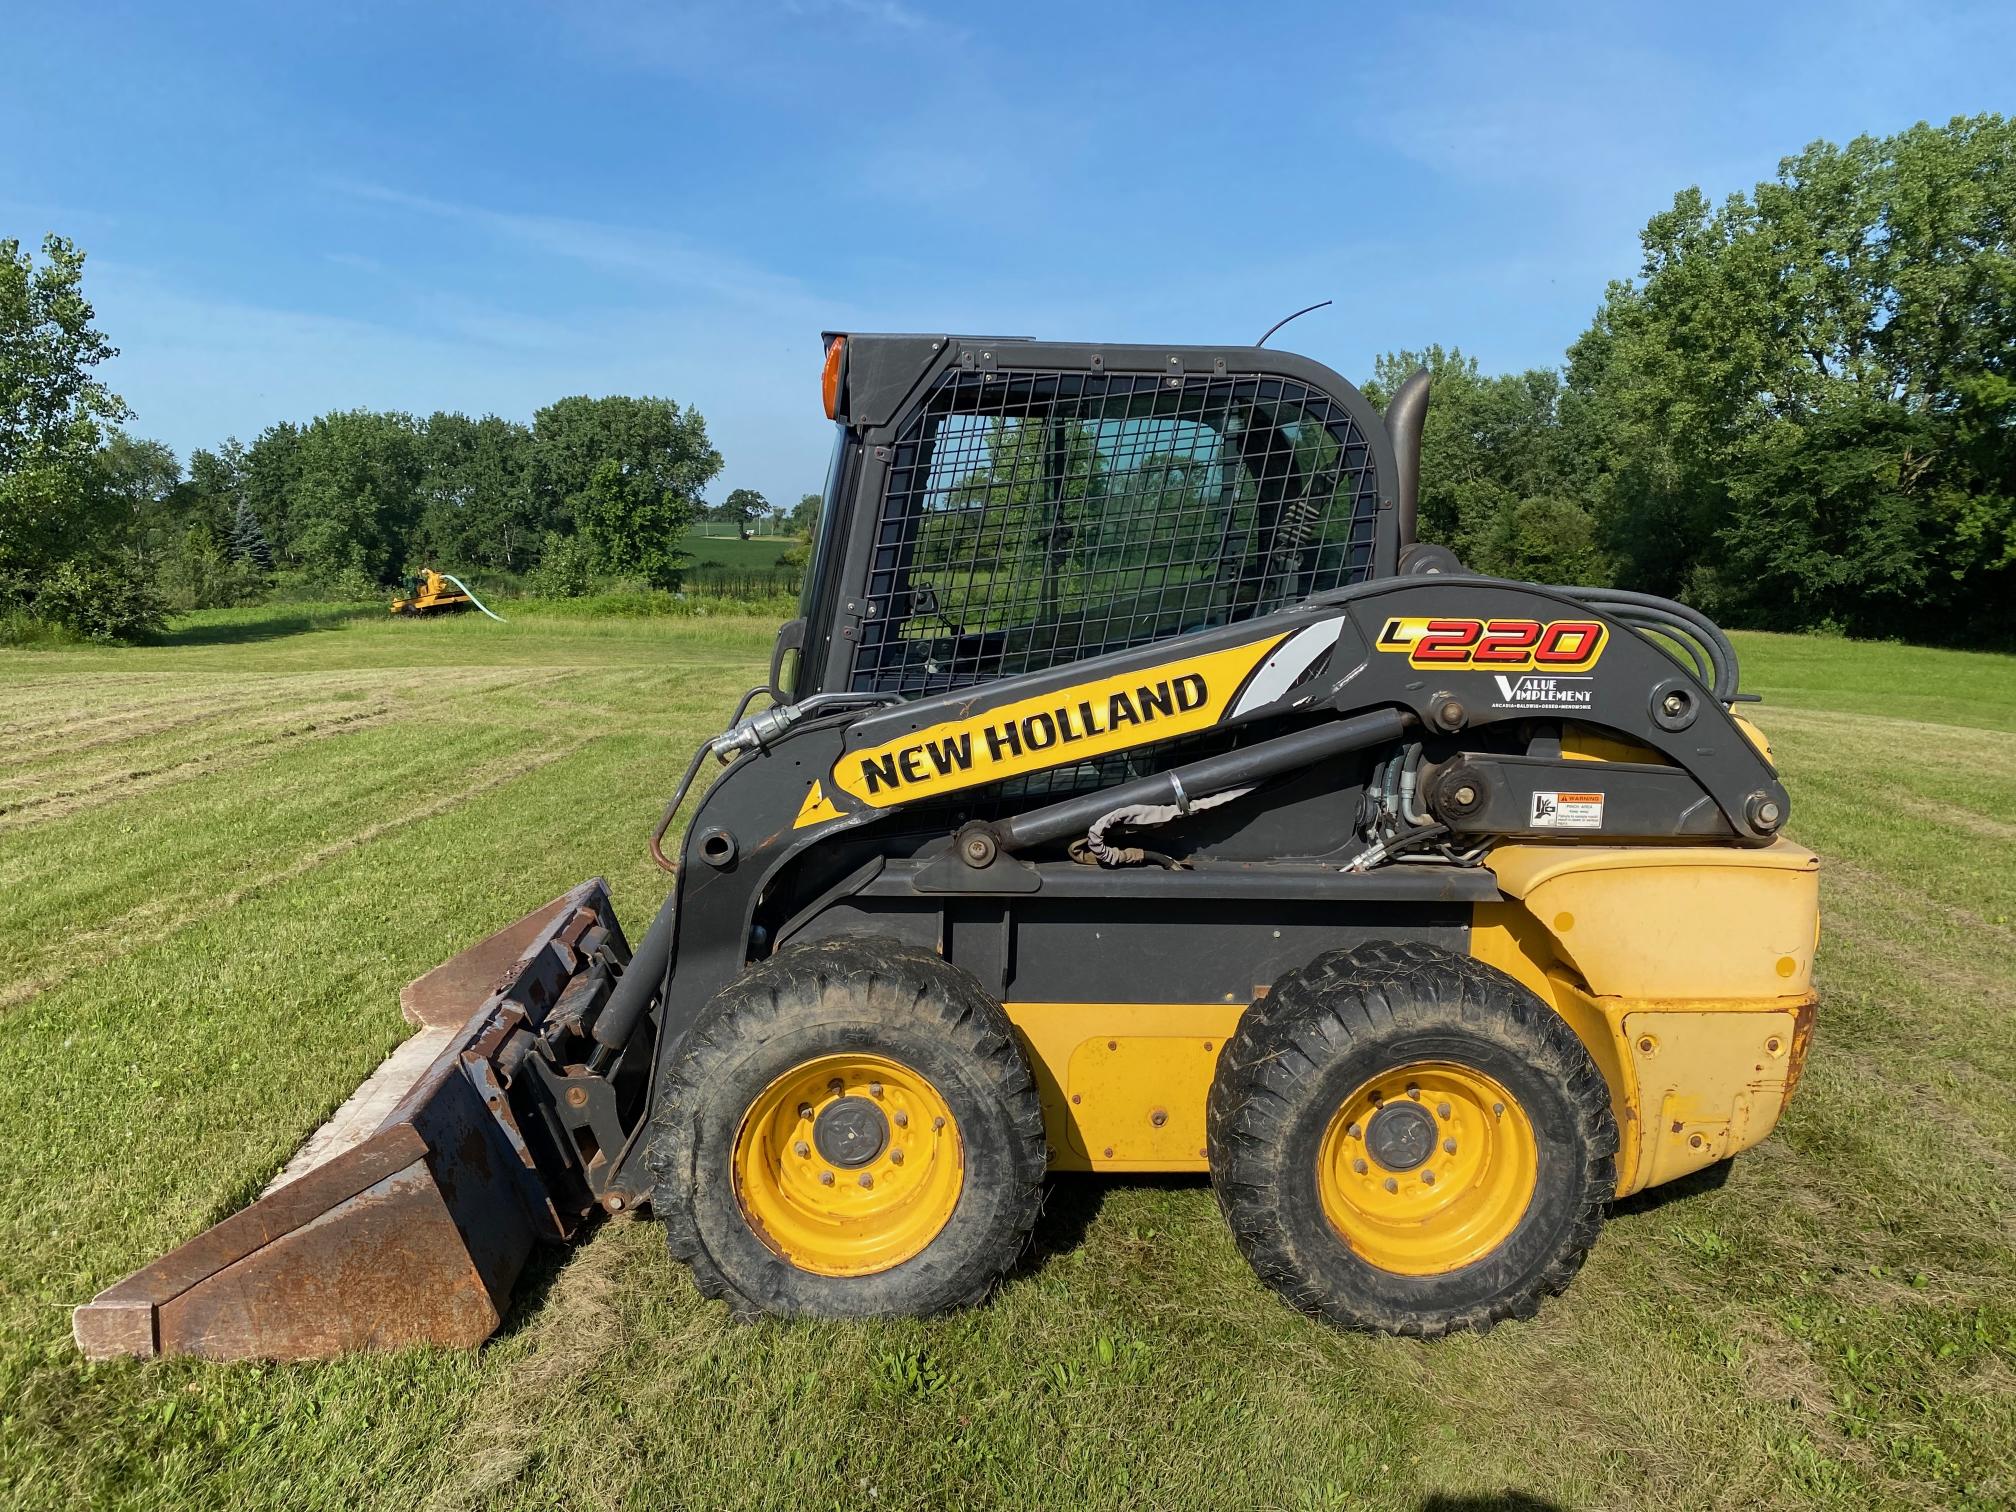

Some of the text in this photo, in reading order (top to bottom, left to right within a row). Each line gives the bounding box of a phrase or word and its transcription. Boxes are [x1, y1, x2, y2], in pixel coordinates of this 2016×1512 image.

[1516, 690, 1592, 702] IMPLEMENT
[860, 673, 1208, 794] NEW HOLLAND
